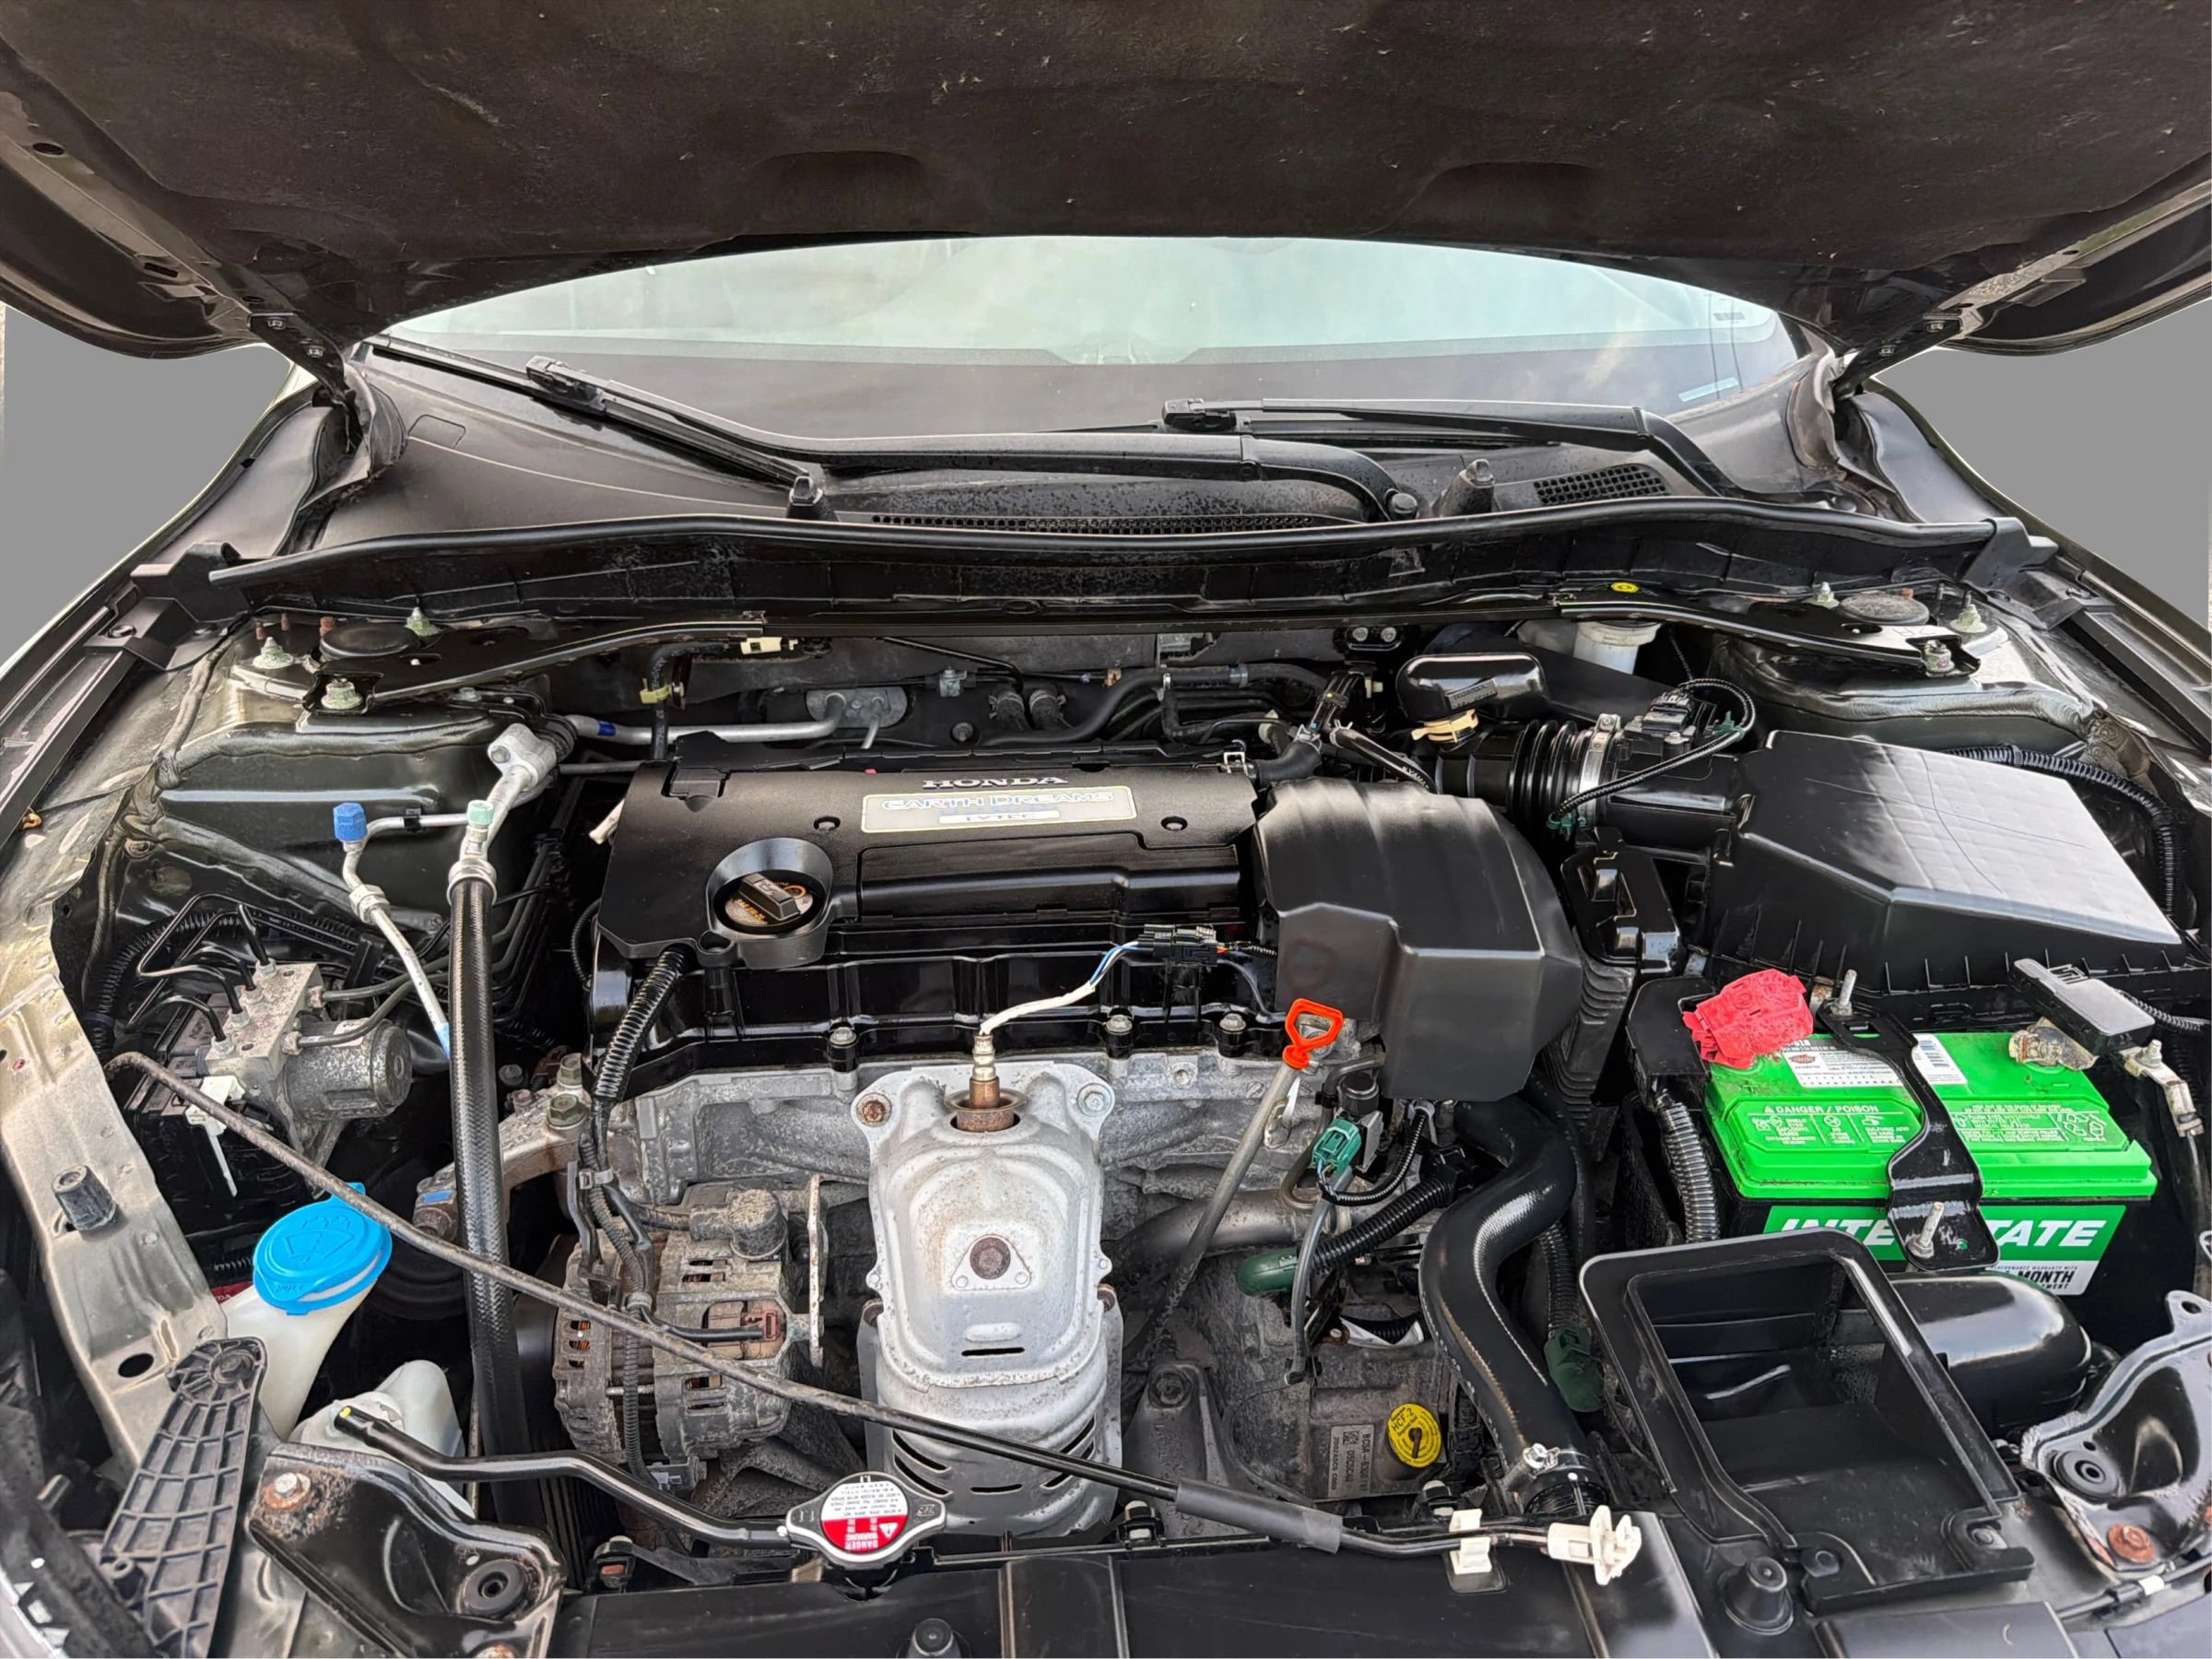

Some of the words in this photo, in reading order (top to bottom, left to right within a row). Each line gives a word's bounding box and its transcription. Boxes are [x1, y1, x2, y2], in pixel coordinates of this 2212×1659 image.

[922, 777, 1068, 790] HONDA
[881, 795, 985, 811] EARTH
[1393, 1407, 1415, 1431] HCF-2
[845, 1532, 878, 1541] WARNING
[844, 1540, 879, 1550] DANGER
